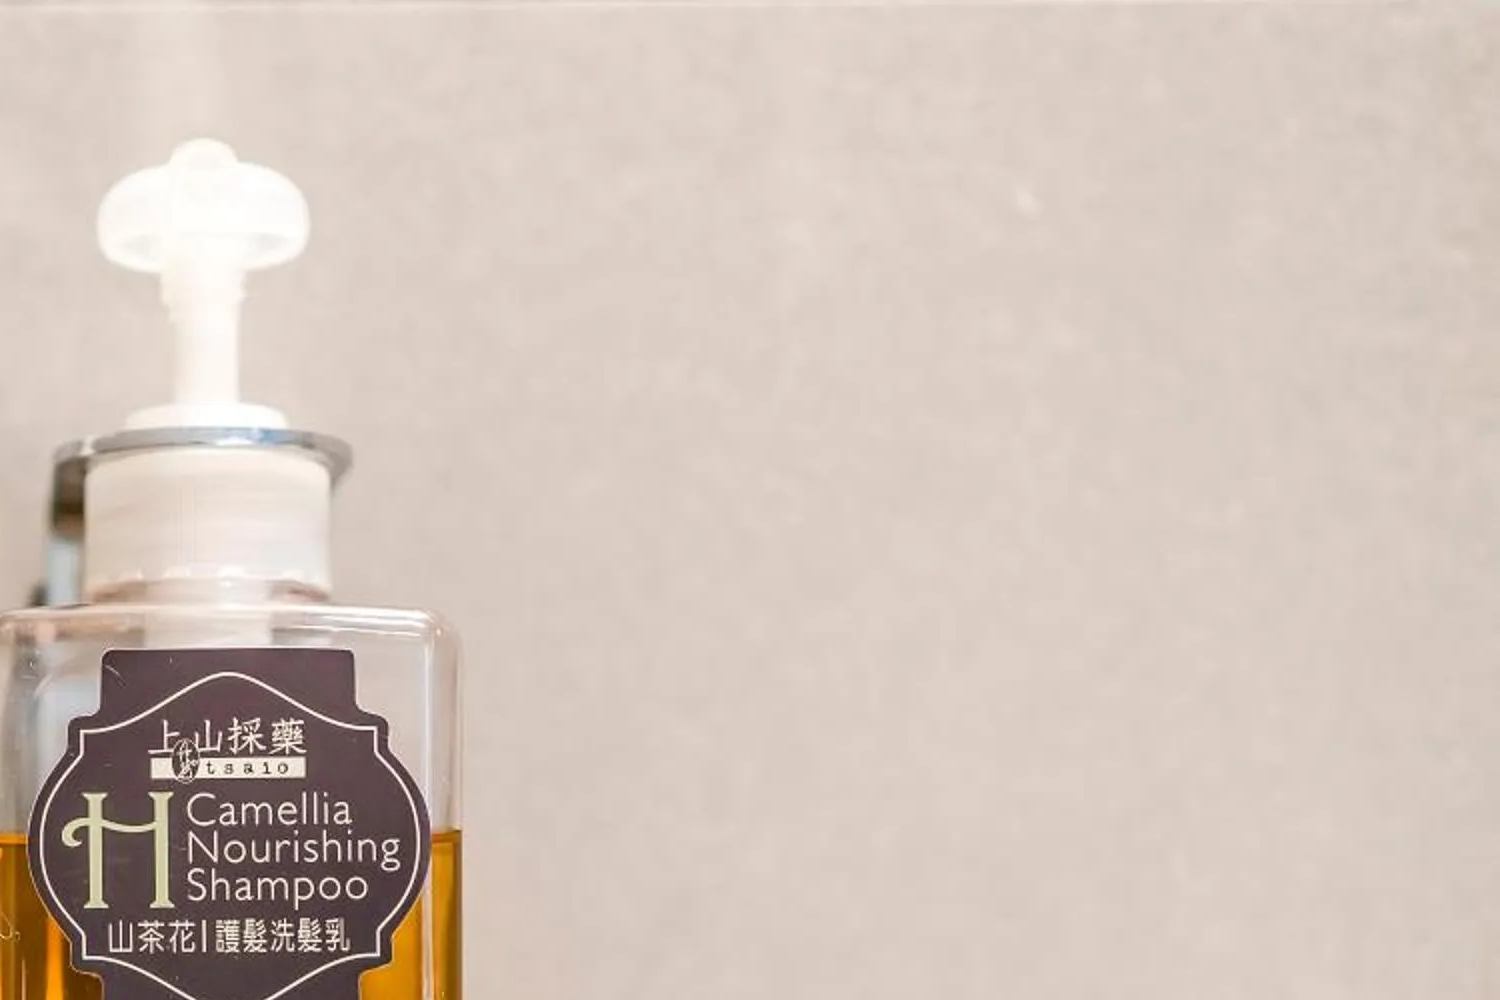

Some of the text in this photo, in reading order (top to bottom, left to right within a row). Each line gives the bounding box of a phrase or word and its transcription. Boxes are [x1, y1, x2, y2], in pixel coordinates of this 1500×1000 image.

[148, 718, 308, 755] 上山採藥
[205, 760, 290, 775] tsaio
[186, 792, 352, 826] Camellia
[187, 830, 401, 871] Nourishing
[187, 869, 369, 910] Shampoo
